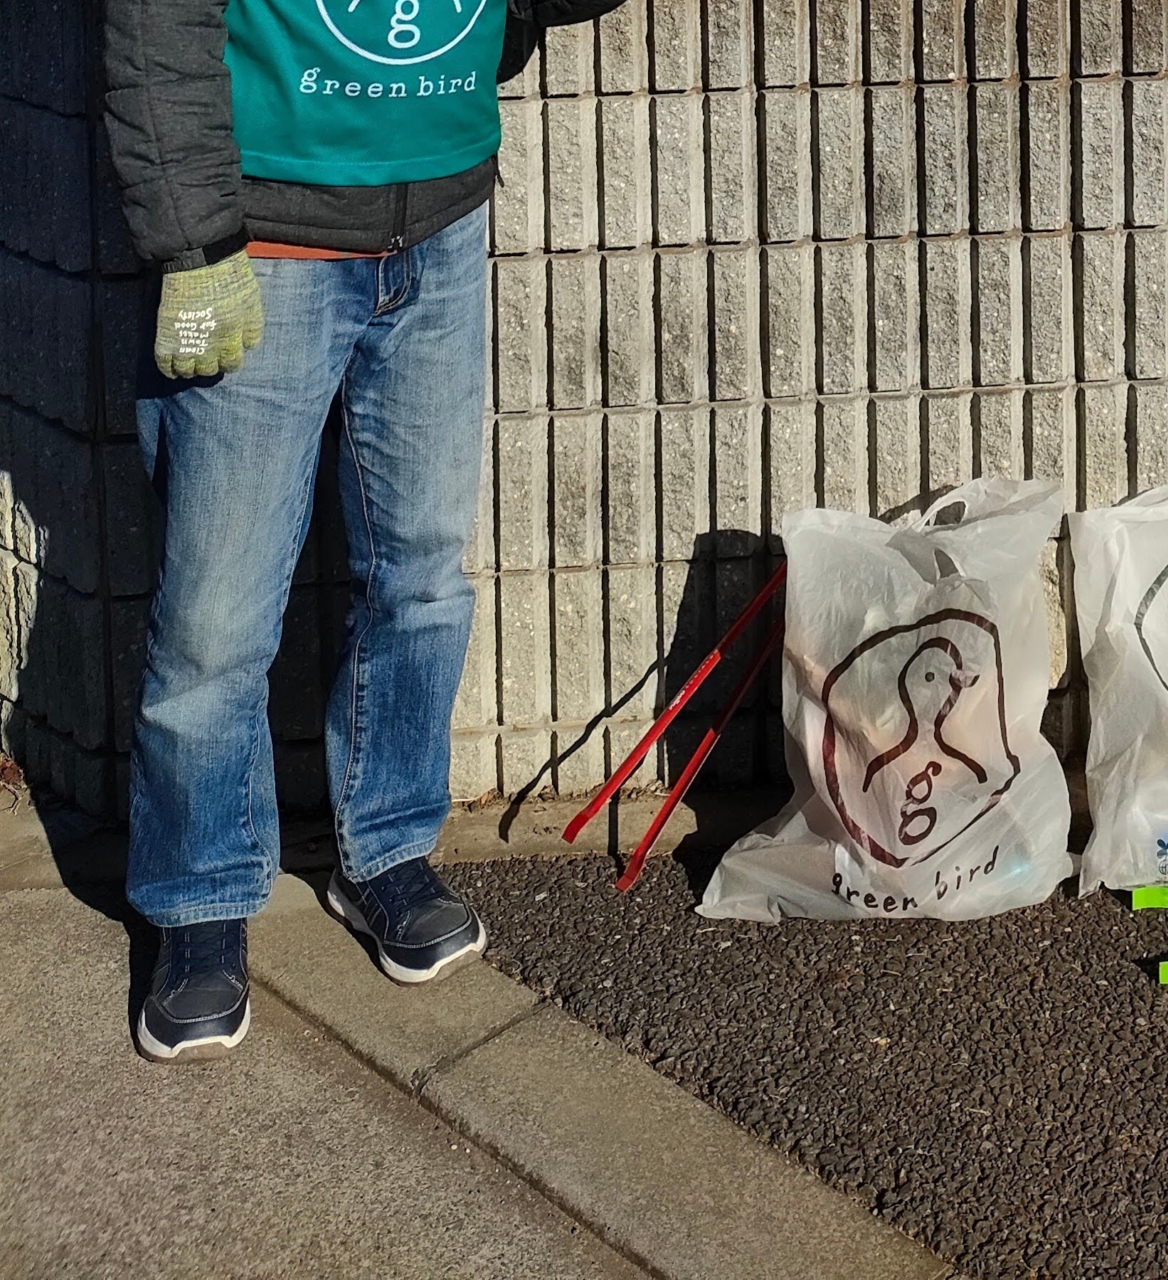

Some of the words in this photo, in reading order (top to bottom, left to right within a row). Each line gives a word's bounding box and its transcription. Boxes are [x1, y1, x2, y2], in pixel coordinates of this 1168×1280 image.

[299, 67, 407, 98] green
[416, 71, 477, 97] bird
[178, 307, 213, 321] Society
[174, 322, 197, 331] Good
[199, 319, 217, 331] for
[179, 330, 209, 338] Makes
[181, 338, 209, 347] Town
[179, 347, 205, 355] Clean
[898, 760, 942, 846] g
[831, 872, 918, 913] green
[934, 845, 1000, 901] bird
